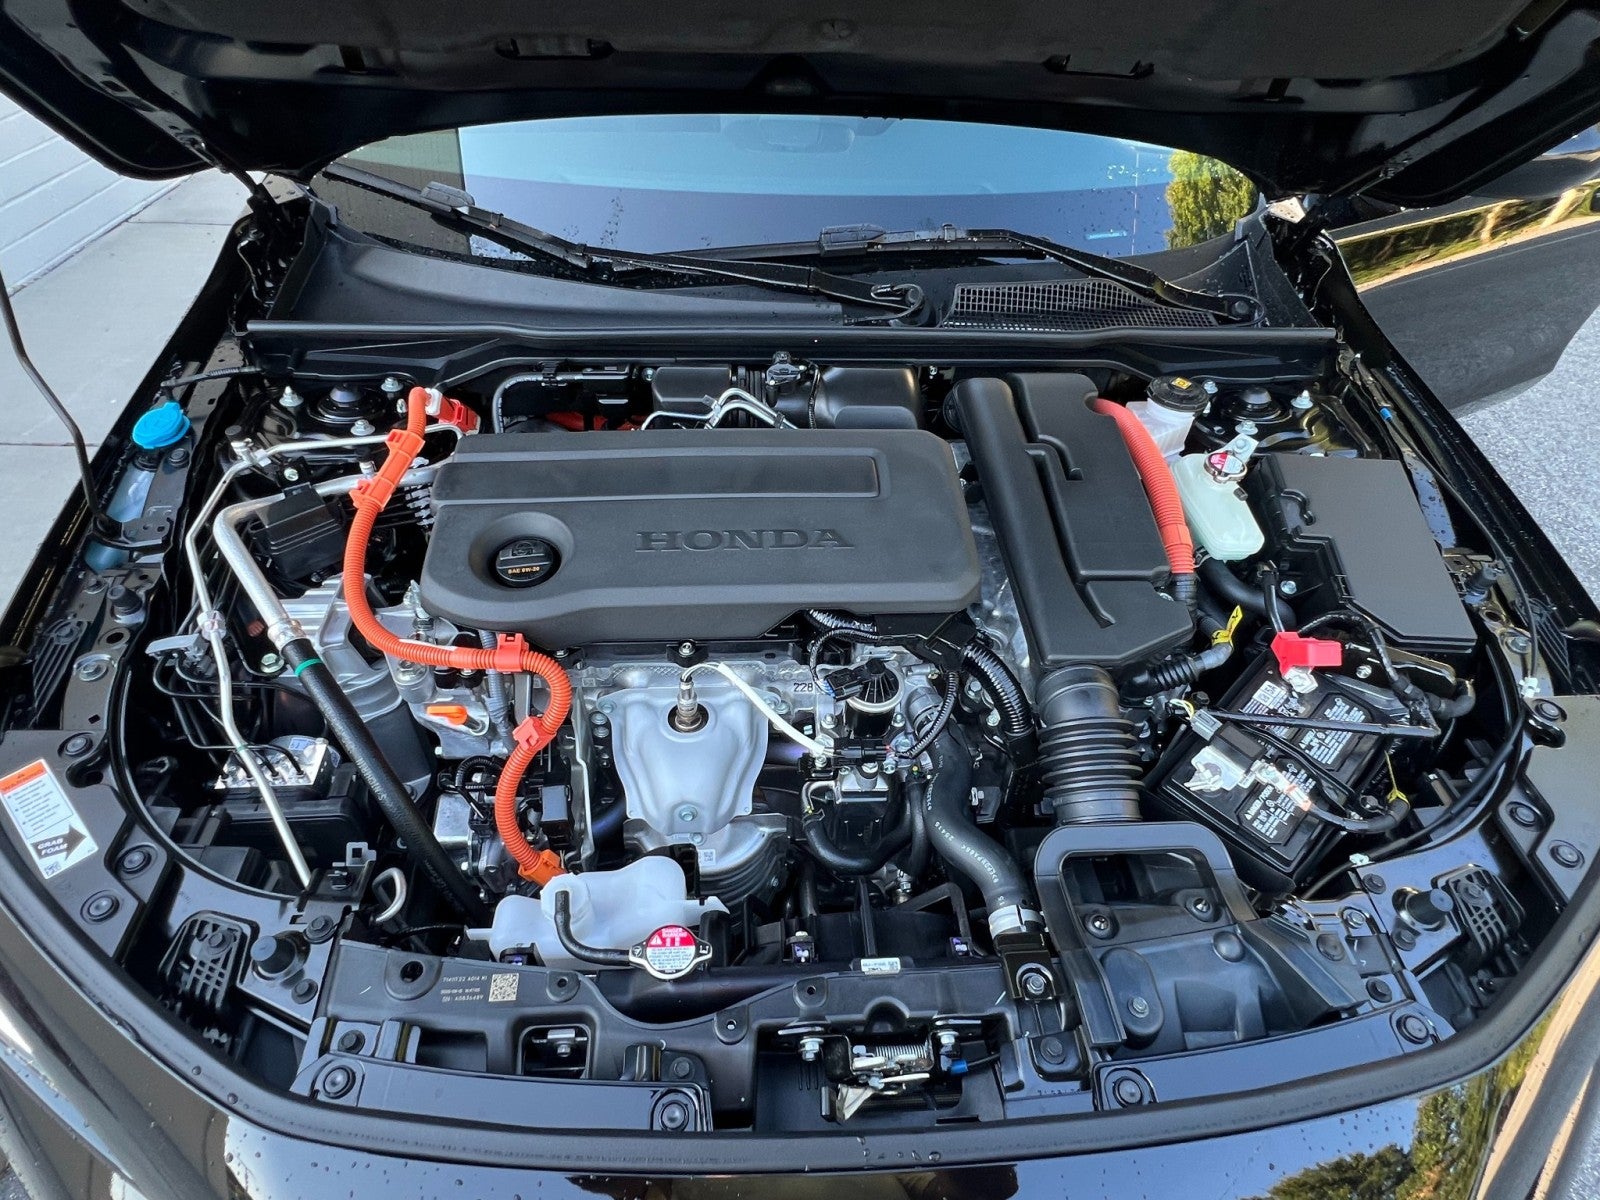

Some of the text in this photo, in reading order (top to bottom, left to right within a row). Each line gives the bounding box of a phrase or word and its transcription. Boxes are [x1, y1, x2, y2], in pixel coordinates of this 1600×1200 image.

[635, 528, 854, 552] HONDA
[793, 682, 813, 692] 228
[37, 838, 64, 850] GRAB
[41, 844, 68, 856] FOAM
